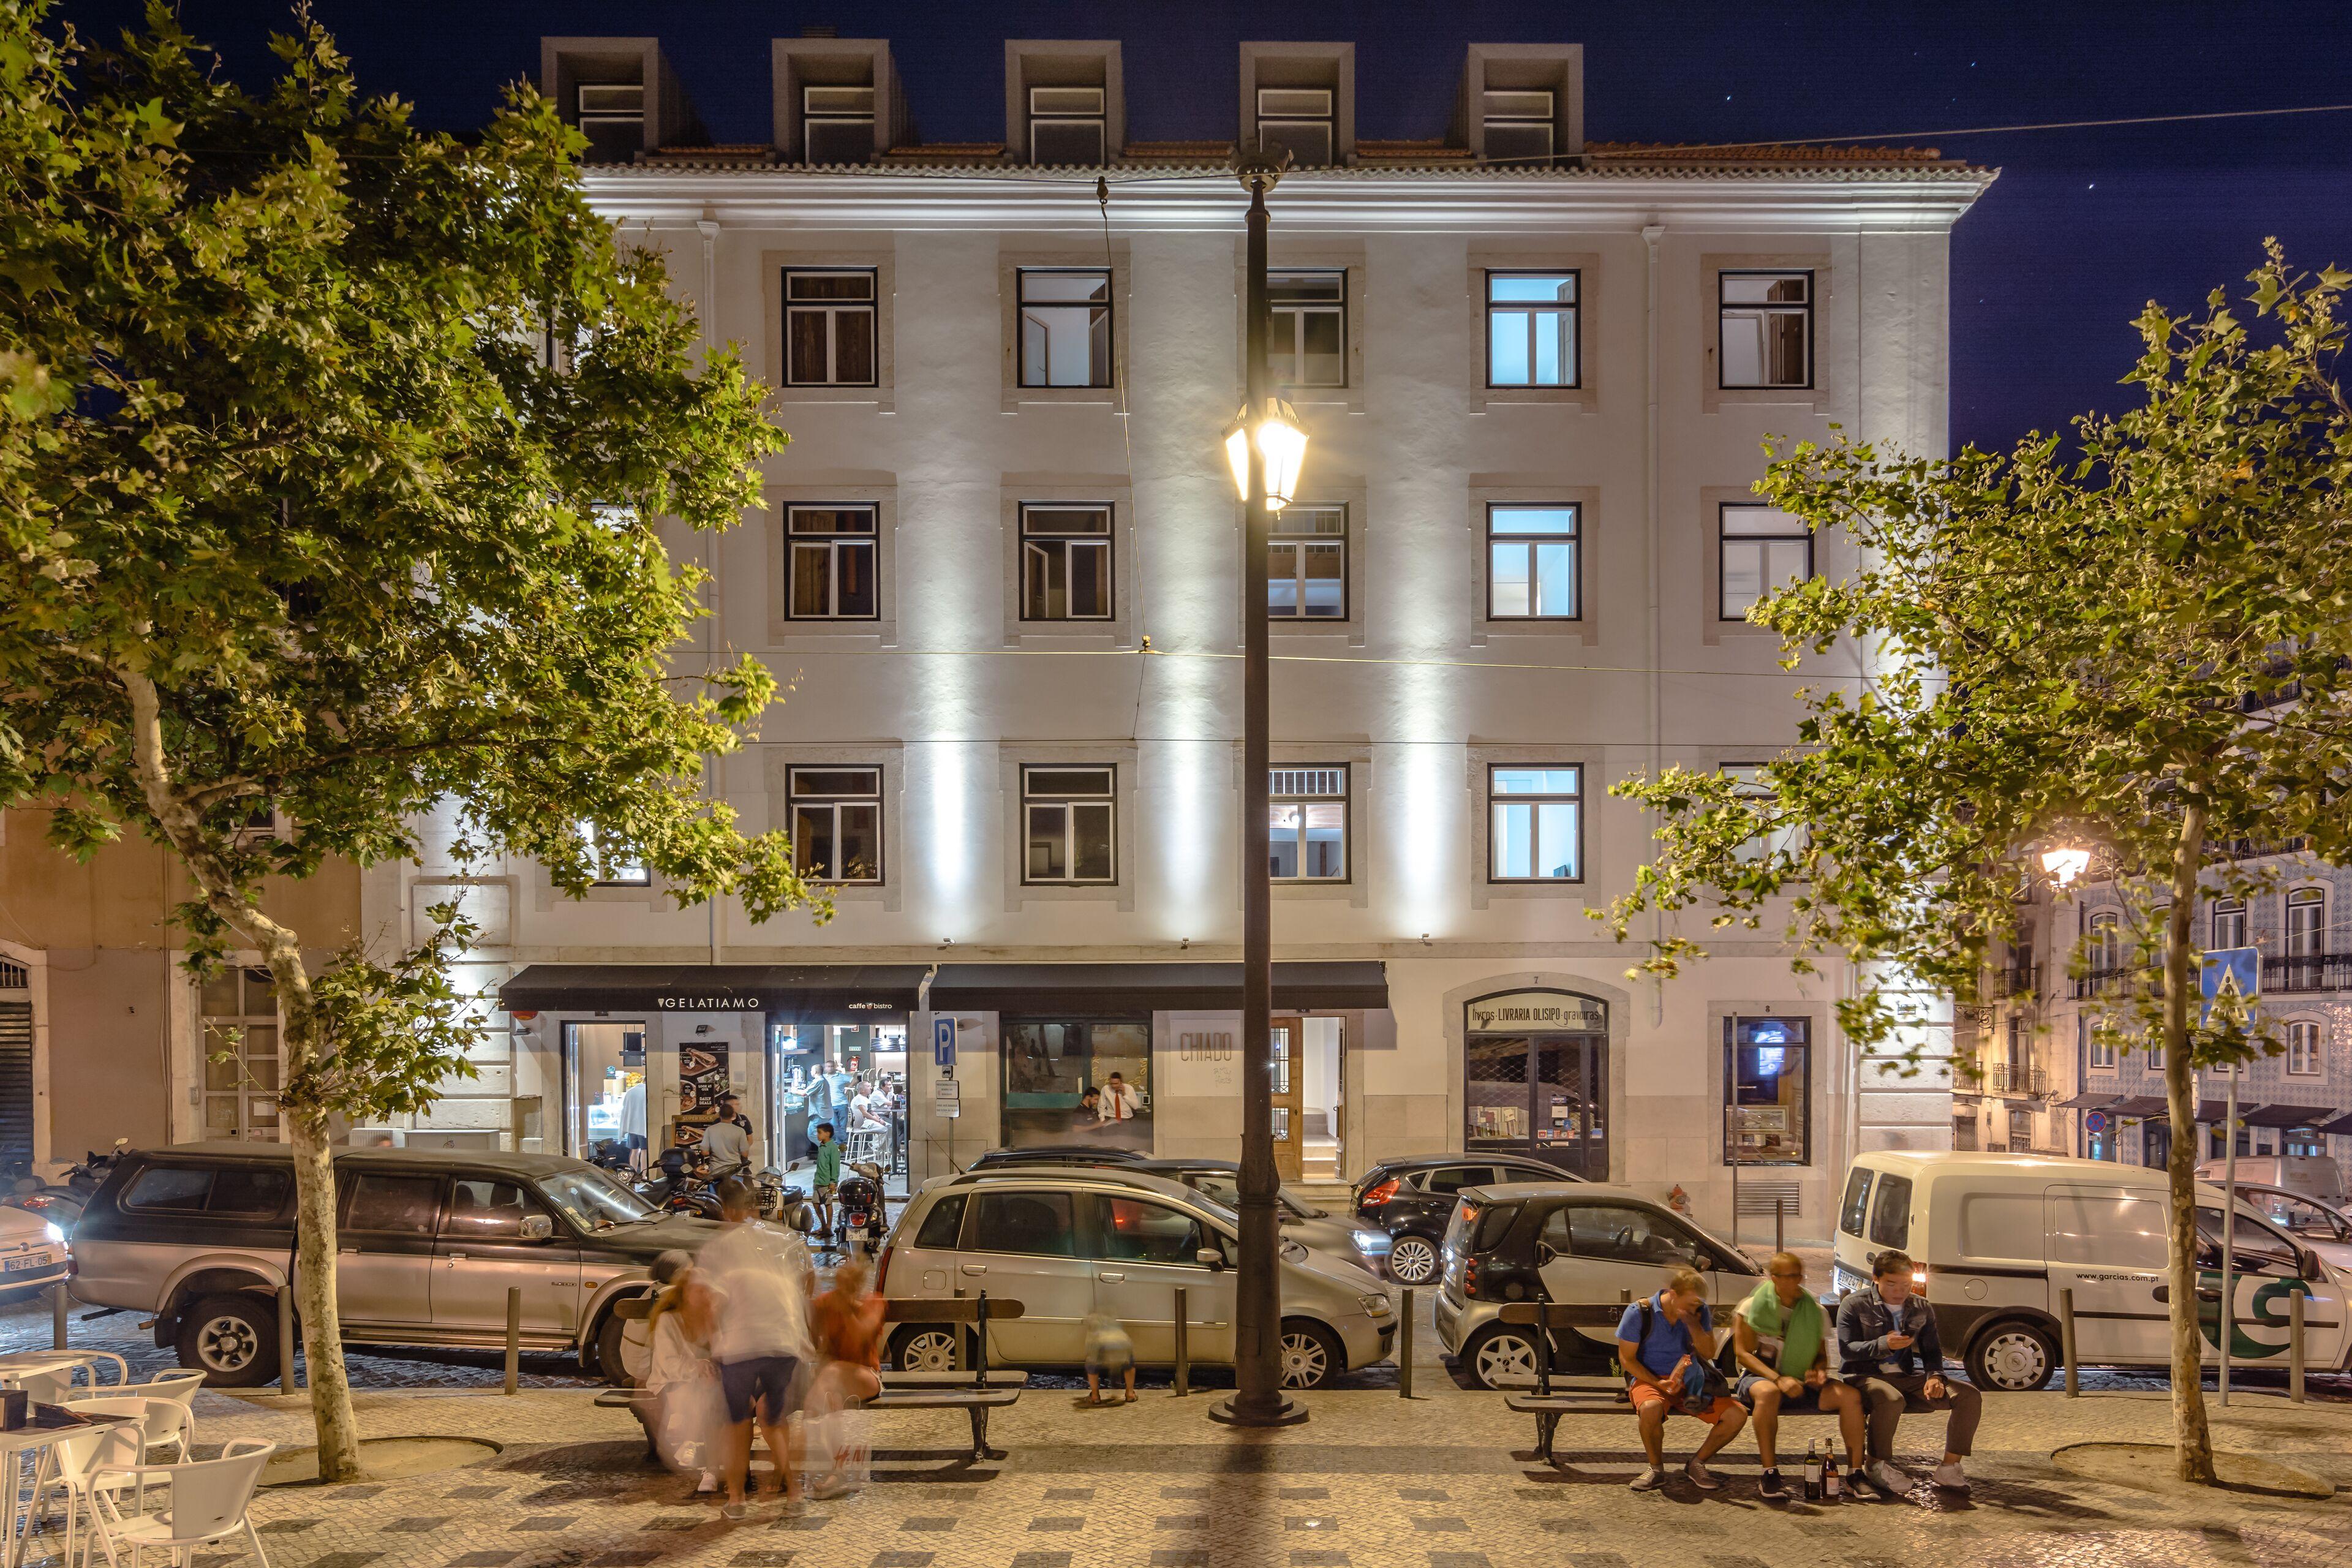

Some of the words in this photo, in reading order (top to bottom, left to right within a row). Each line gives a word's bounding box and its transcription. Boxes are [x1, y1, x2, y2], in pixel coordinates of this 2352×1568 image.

[665, 998, 759, 1008] GELATIAMO
[1498, 1008, 1531, 1021] LIVRARIA
[1533, 1008, 1560, 1020] OLISIPO
[938, 1023, 951, 1061] P
[1180, 1033, 1232, 1061] CHIADO
[2076, 1273, 2160, 1283] www.garcias.com.pt
